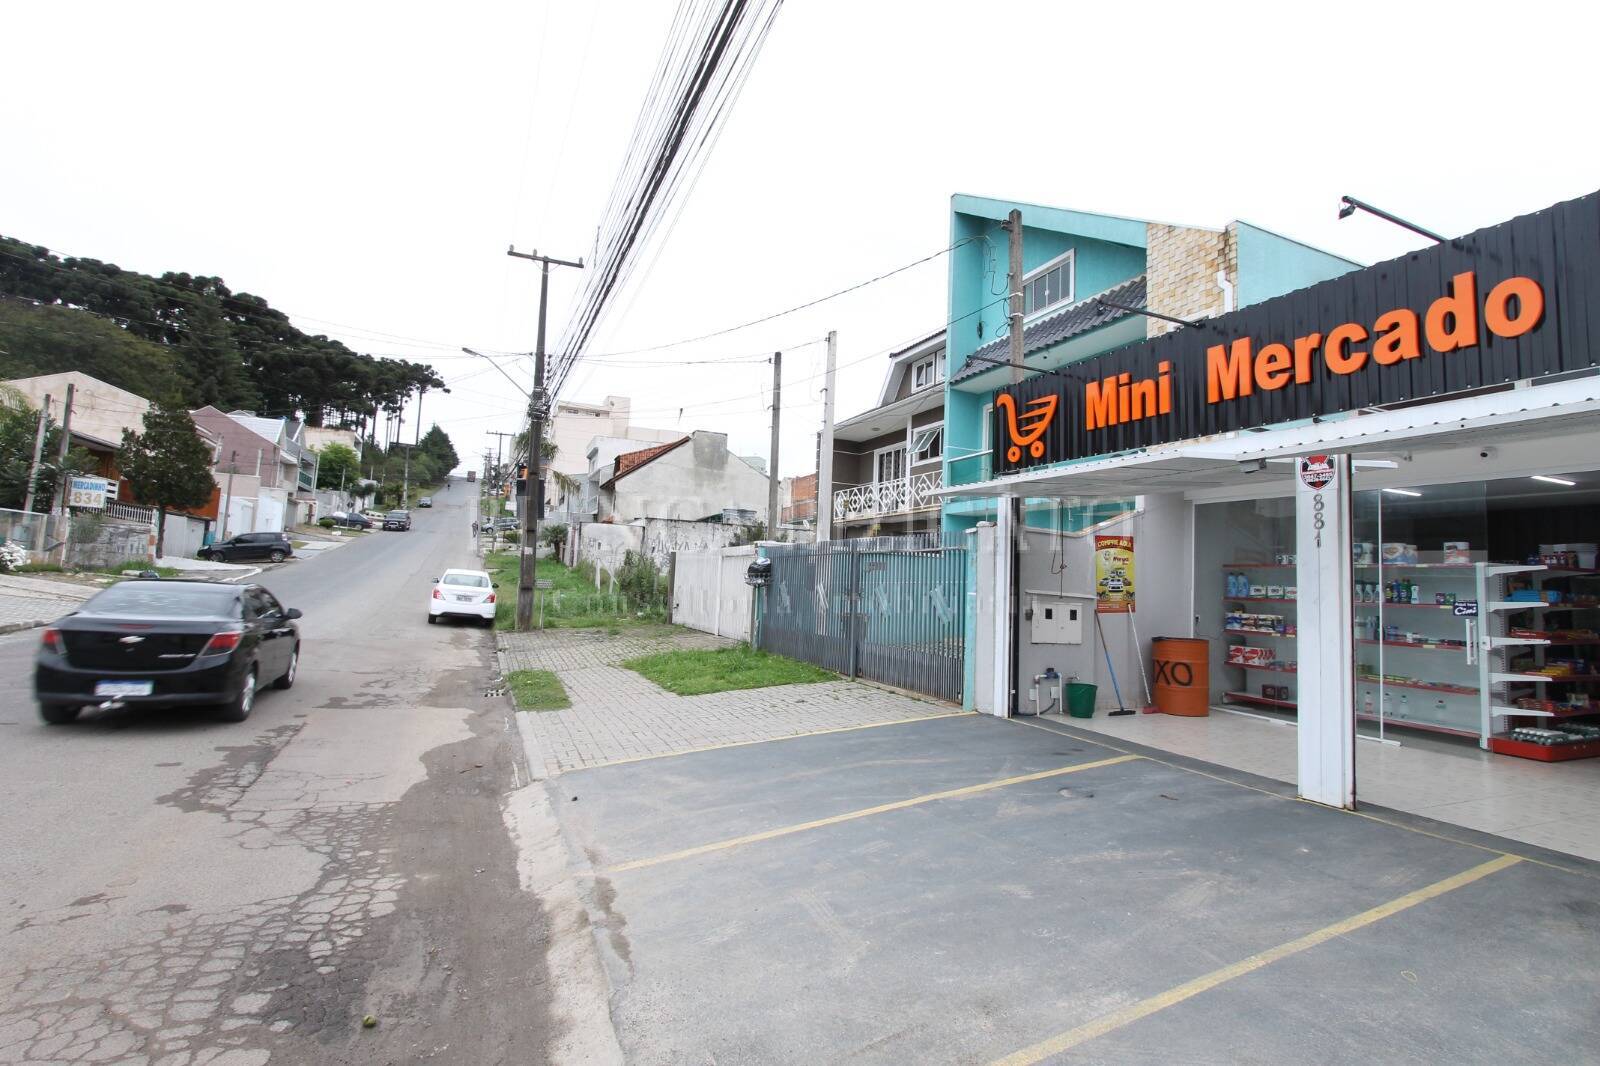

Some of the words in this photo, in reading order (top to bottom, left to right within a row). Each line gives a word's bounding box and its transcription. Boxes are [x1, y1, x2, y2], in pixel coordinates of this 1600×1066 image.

[1086, 361, 1171, 432] Mini
[1207, 271, 1545, 404] Mercado
[74, 491, 101, 505] 834
